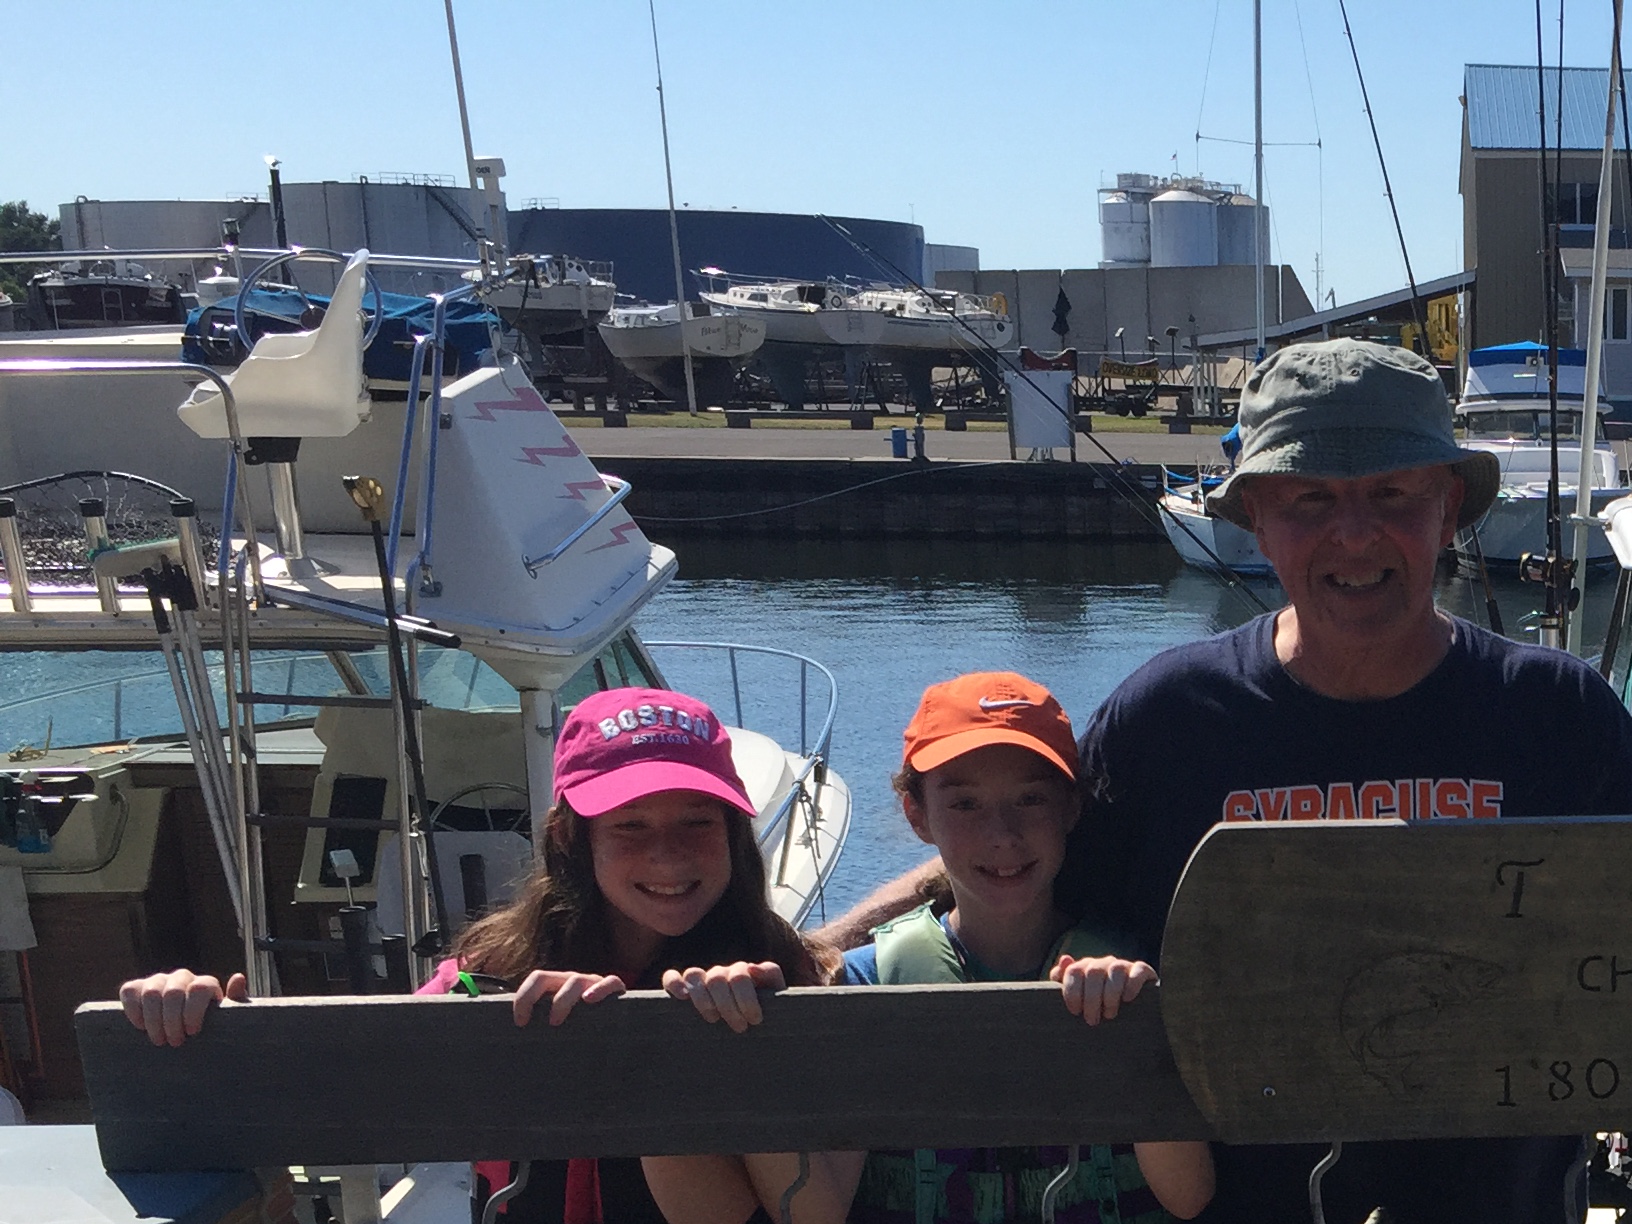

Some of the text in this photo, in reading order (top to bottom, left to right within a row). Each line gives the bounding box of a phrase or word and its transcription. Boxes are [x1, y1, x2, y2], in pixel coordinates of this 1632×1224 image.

[598, 705, 709, 740] BOSTON
[1222, 778, 1503, 820] SYRACUSE
[1496, 858, 1544, 918] T
